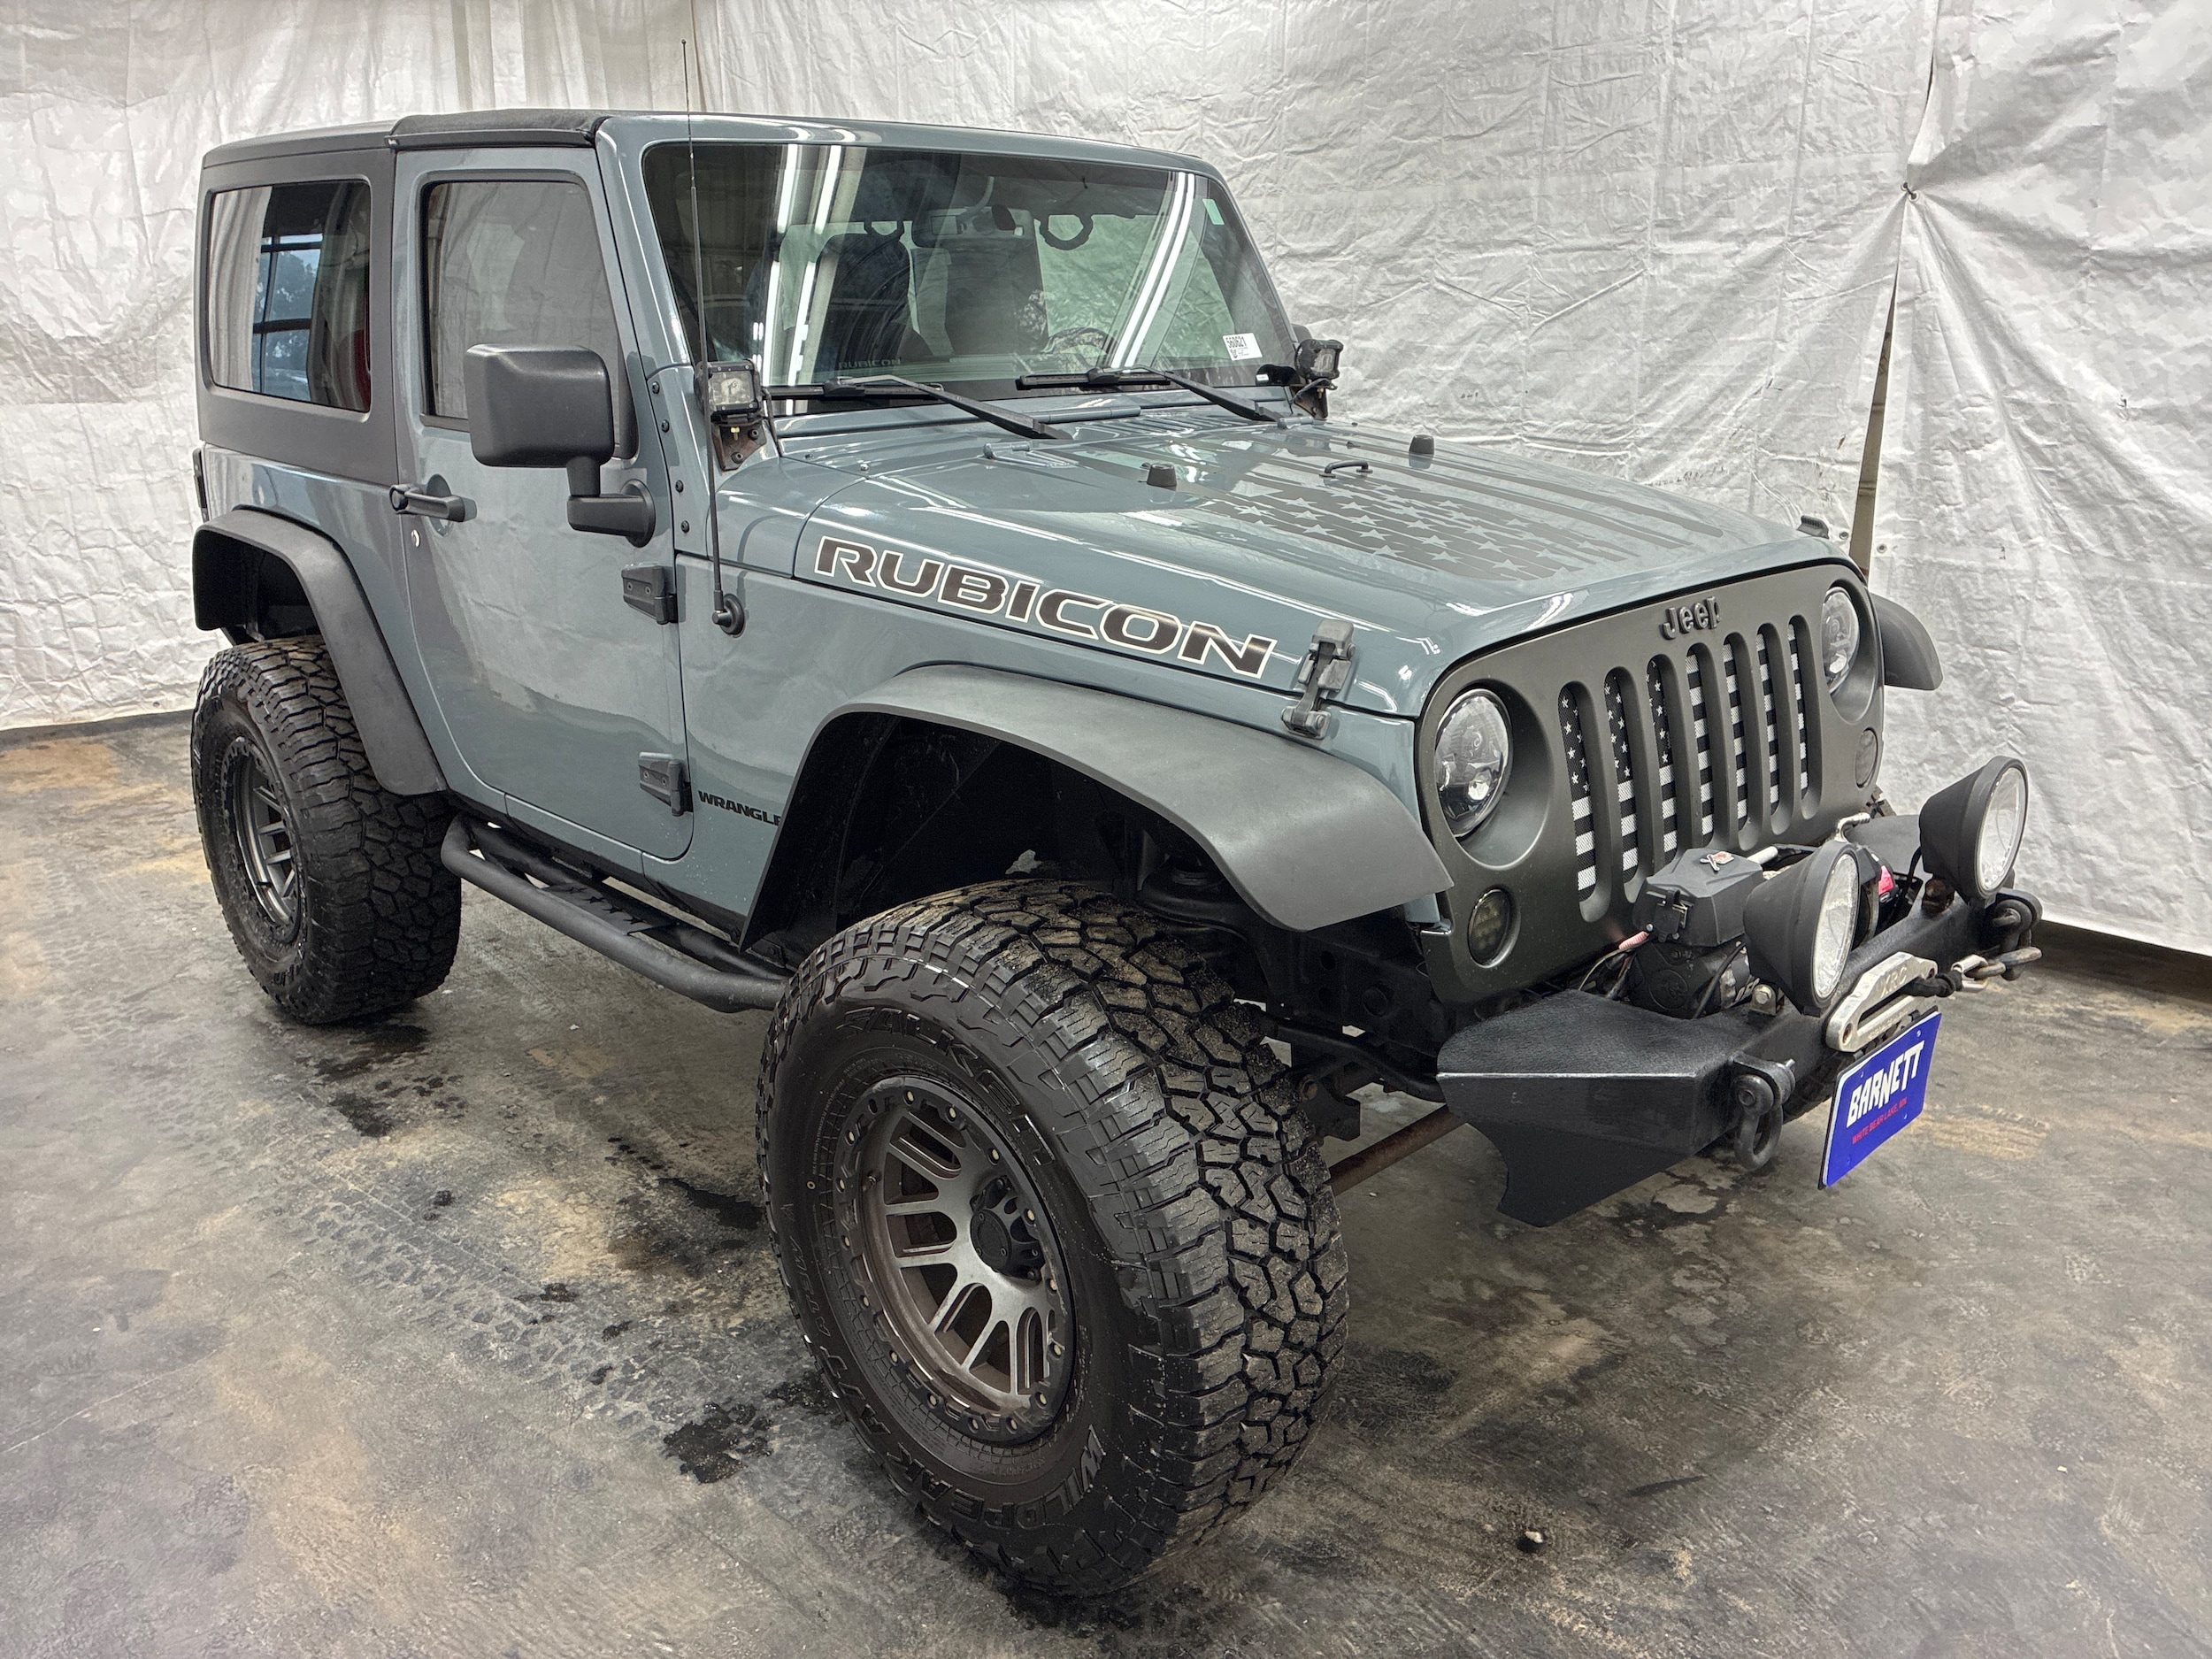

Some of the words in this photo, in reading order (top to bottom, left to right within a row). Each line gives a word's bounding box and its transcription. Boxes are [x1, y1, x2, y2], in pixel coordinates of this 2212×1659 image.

[838, 359, 902, 370] RUBICON
[814, 535, 1278, 679] RUBICON
[1660, 595, 1721, 640] Jeep
[836, 1007, 1056, 1165] FALKEN
[1846, 1040, 1924, 1128] BARNETT
[1852, 1124, 1870, 1145] WHITE
[1869, 1113, 1885, 1133] BEAR
[885, 1424, 1106, 1529] WILDPEAK
